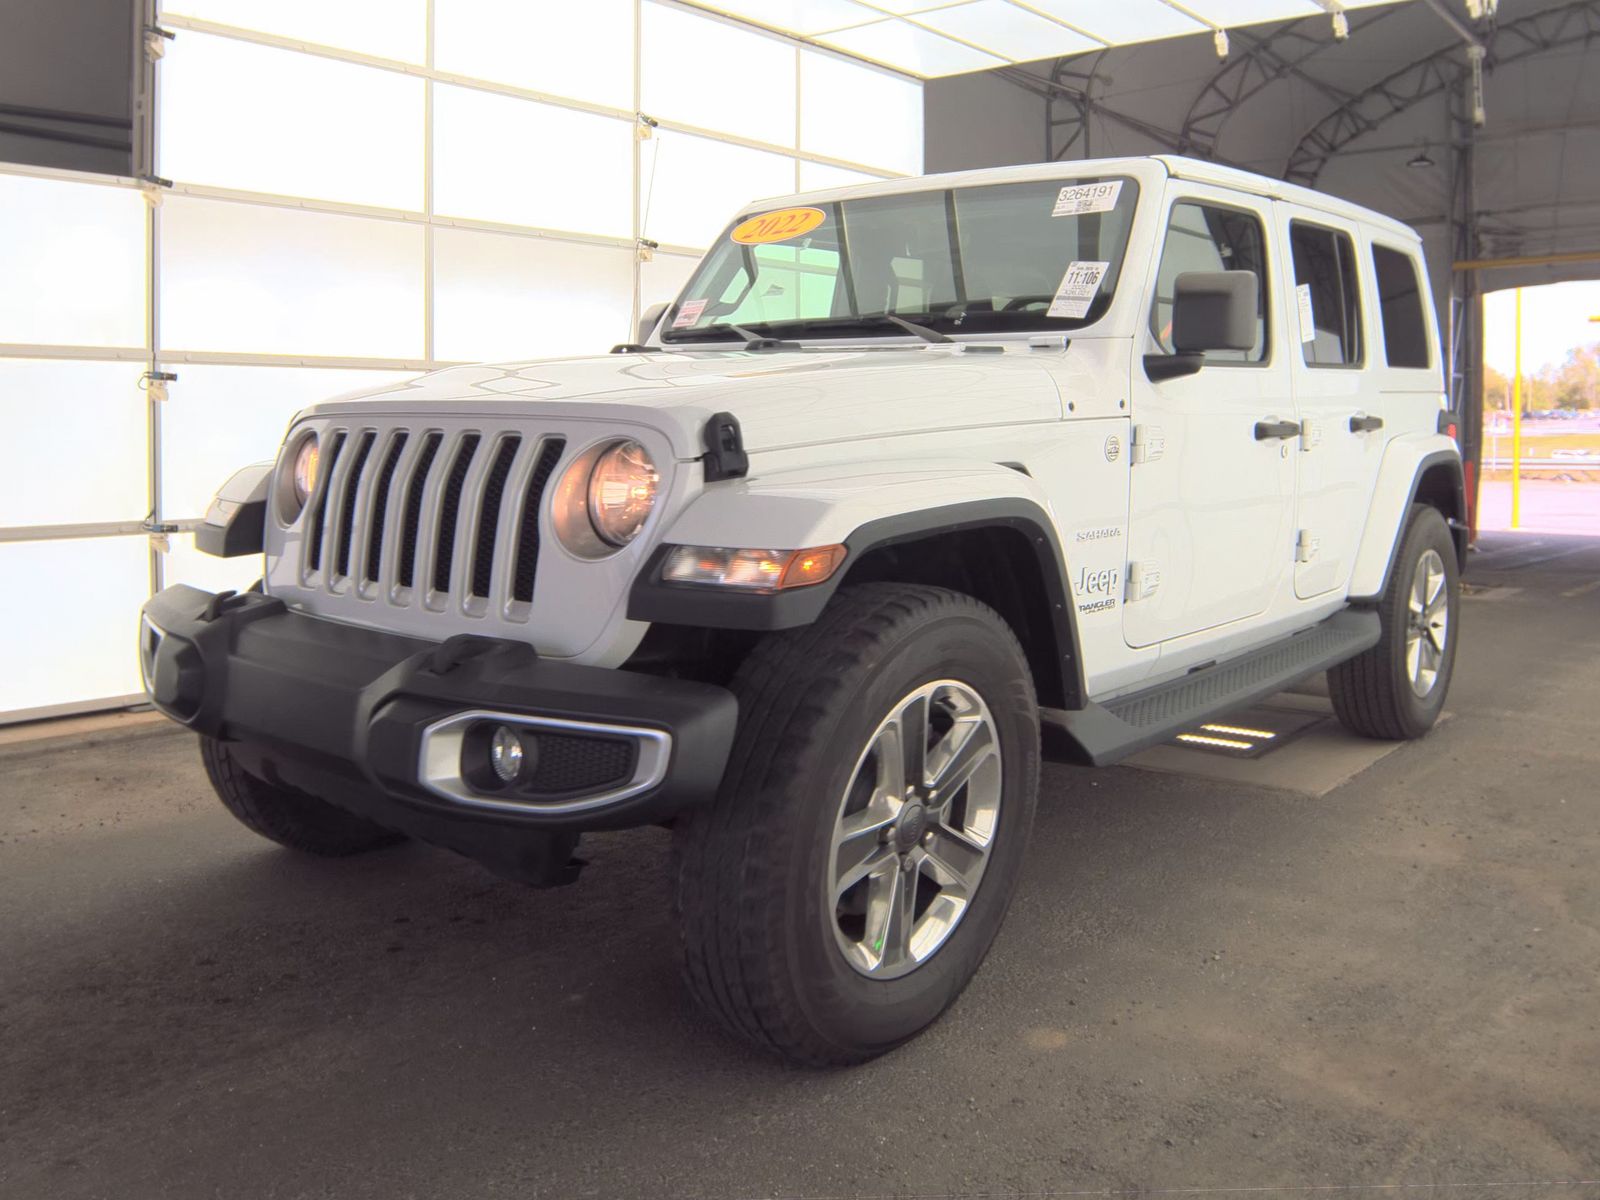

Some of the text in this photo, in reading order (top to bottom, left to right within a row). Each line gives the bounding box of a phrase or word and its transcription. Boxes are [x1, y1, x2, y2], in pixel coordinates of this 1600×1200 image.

[1059, 185, 1114, 202] 3264191
[741, 212, 812, 239] 2022
[1067, 271, 1100, 285] 11:106
[1074, 566, 1118, 596] Jeep
